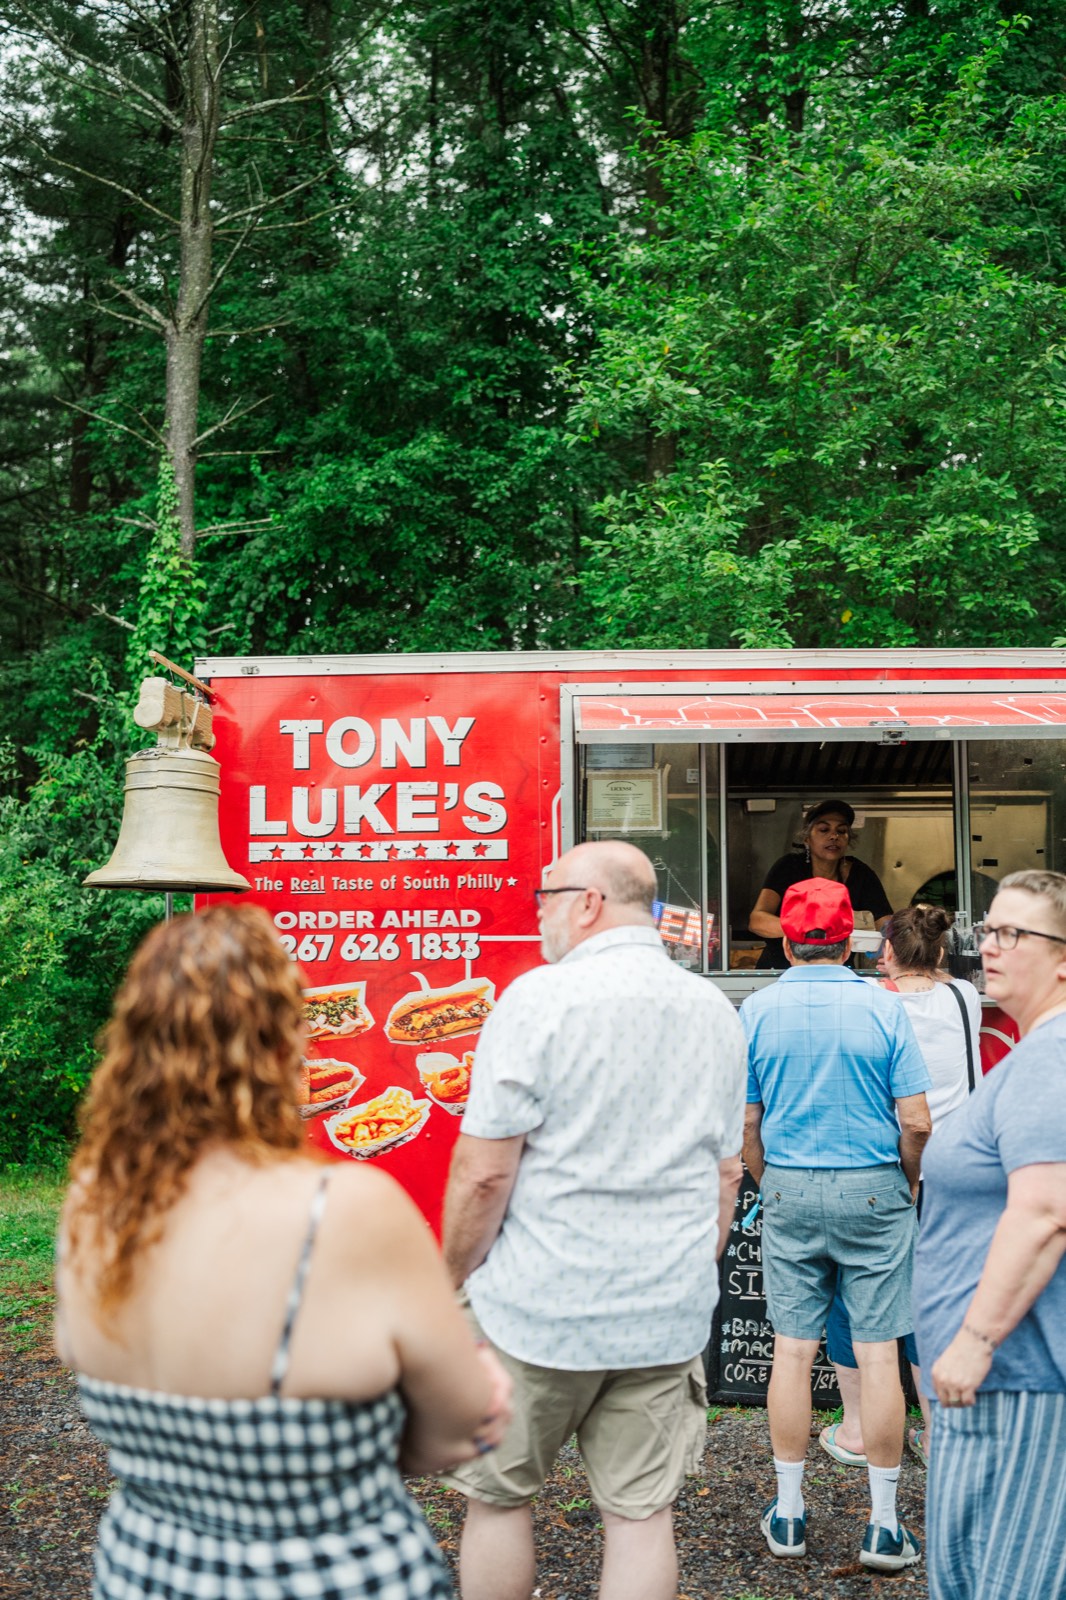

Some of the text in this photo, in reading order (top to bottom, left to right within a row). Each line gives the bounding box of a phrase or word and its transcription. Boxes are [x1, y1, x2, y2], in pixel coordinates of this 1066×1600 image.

[279, 716, 476, 770] TONY
[249, 781, 508, 838] LUKE'S
[254, 874, 503, 892] The Real Taste of South Philly
[273, 909, 481, 930] ORDER AHEAD
[279, 932, 481, 962] 267 626 1833
[732, 1317, 775, 1337] BAK
